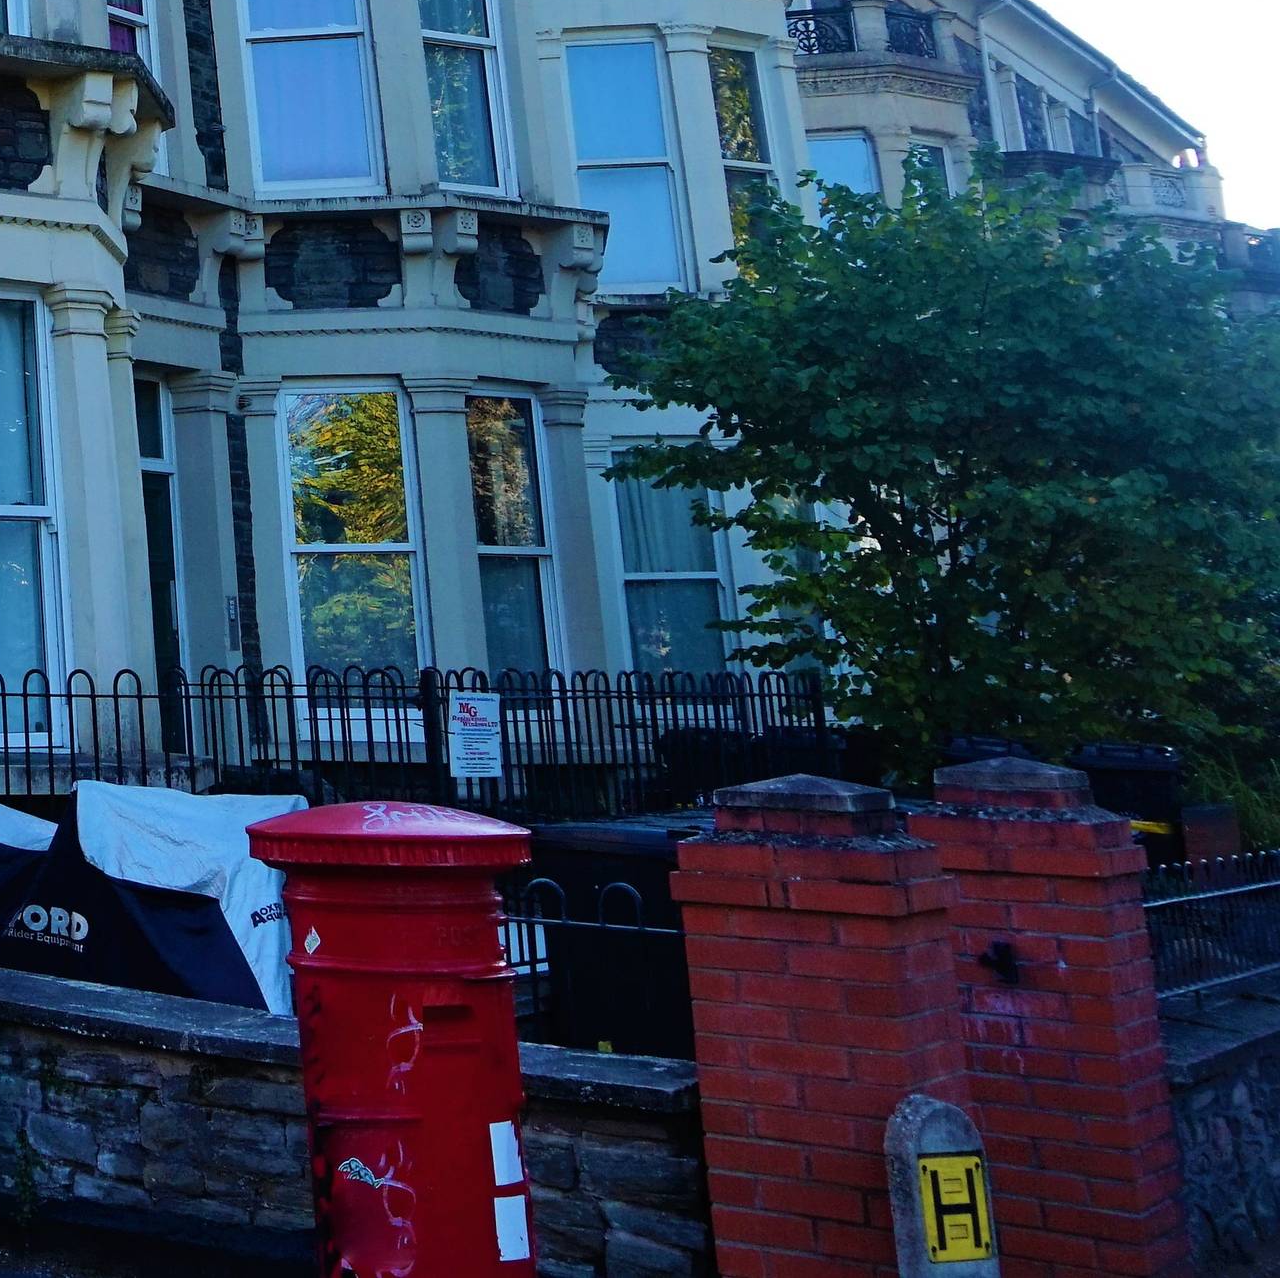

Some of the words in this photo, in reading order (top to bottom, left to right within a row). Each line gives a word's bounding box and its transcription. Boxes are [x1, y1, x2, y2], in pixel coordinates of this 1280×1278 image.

[458, 702, 478, 717] MG
[7, 927, 34, 940] Rider
[17, 904, 89, 941] ORD
[930, 1168, 983, 1251] H
